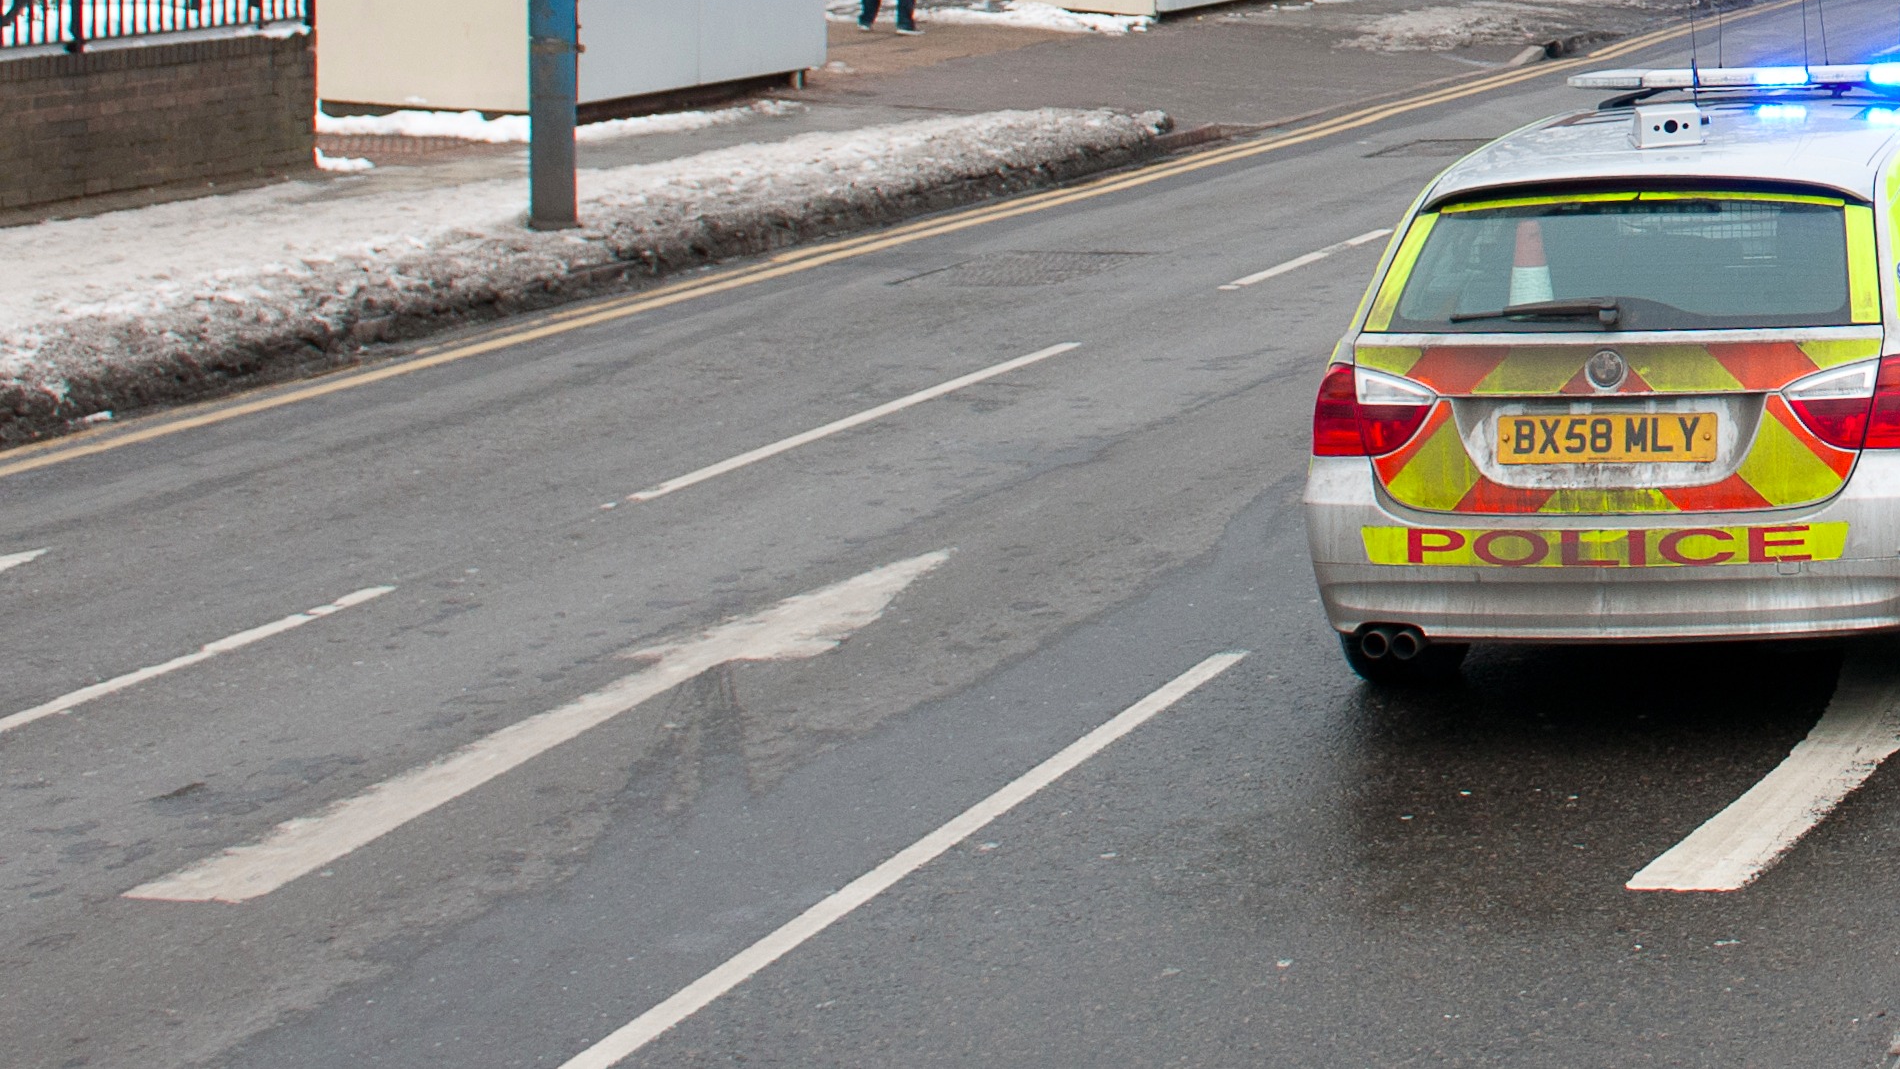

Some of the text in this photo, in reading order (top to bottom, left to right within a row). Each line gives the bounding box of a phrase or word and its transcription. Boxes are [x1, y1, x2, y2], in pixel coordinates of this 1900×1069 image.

[1513, 416, 1700, 455] BX58 MLY
[1407, 525, 1813, 567] POLICE
